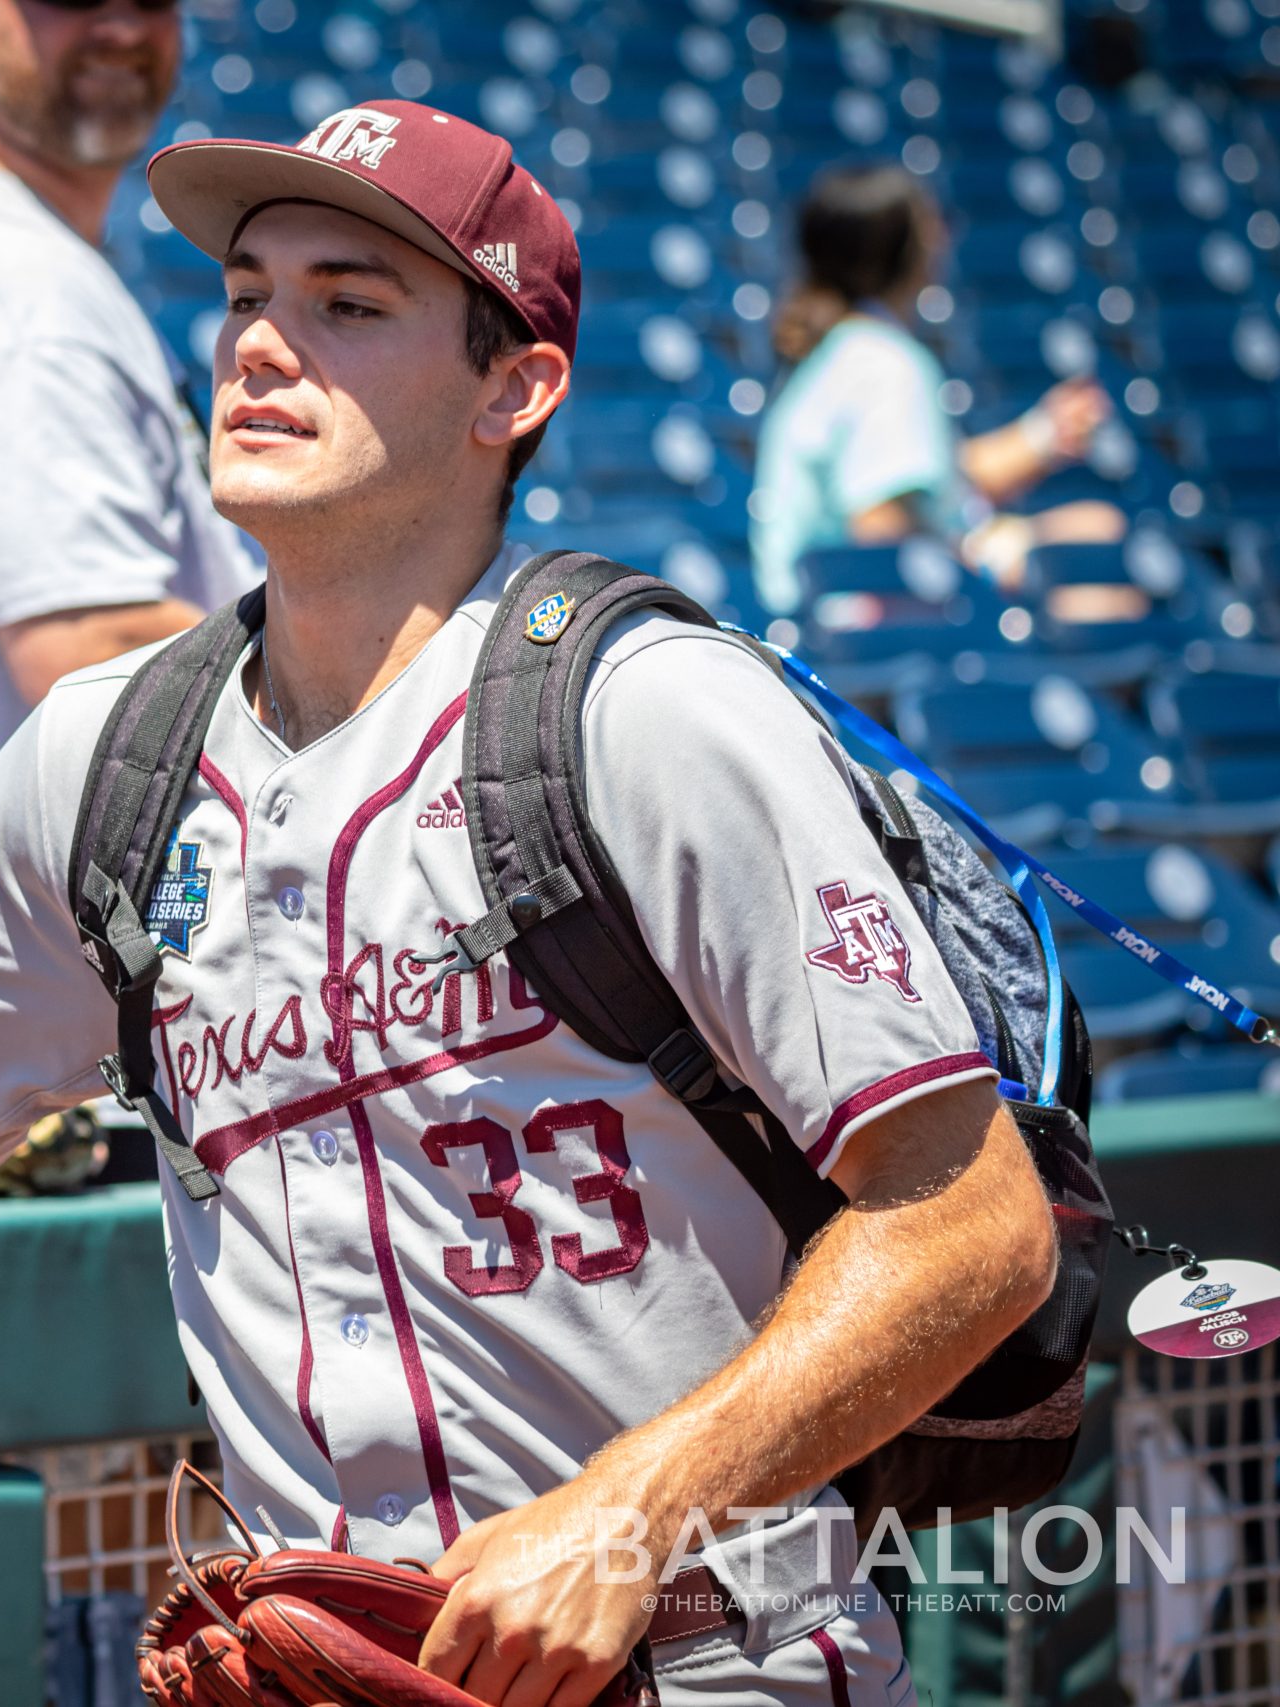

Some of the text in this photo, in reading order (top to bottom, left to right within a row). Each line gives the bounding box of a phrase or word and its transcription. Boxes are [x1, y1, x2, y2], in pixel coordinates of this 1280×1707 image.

[473, 248, 520, 293] adidas
[416, 809, 469, 829] adid
[1041, 872, 1084, 907] NCAA
[157, 902, 205, 921] SERIES
[1114, 927, 1161, 963] NCAA
[1187, 975, 1230, 1011] NCAA
[151, 991, 308, 1120] Texas
[420, 1098, 651, 1298] 33
[1198, 1314, 1248, 1333] PALISCH
[1200, 1310, 1239, 1326] JACOB
